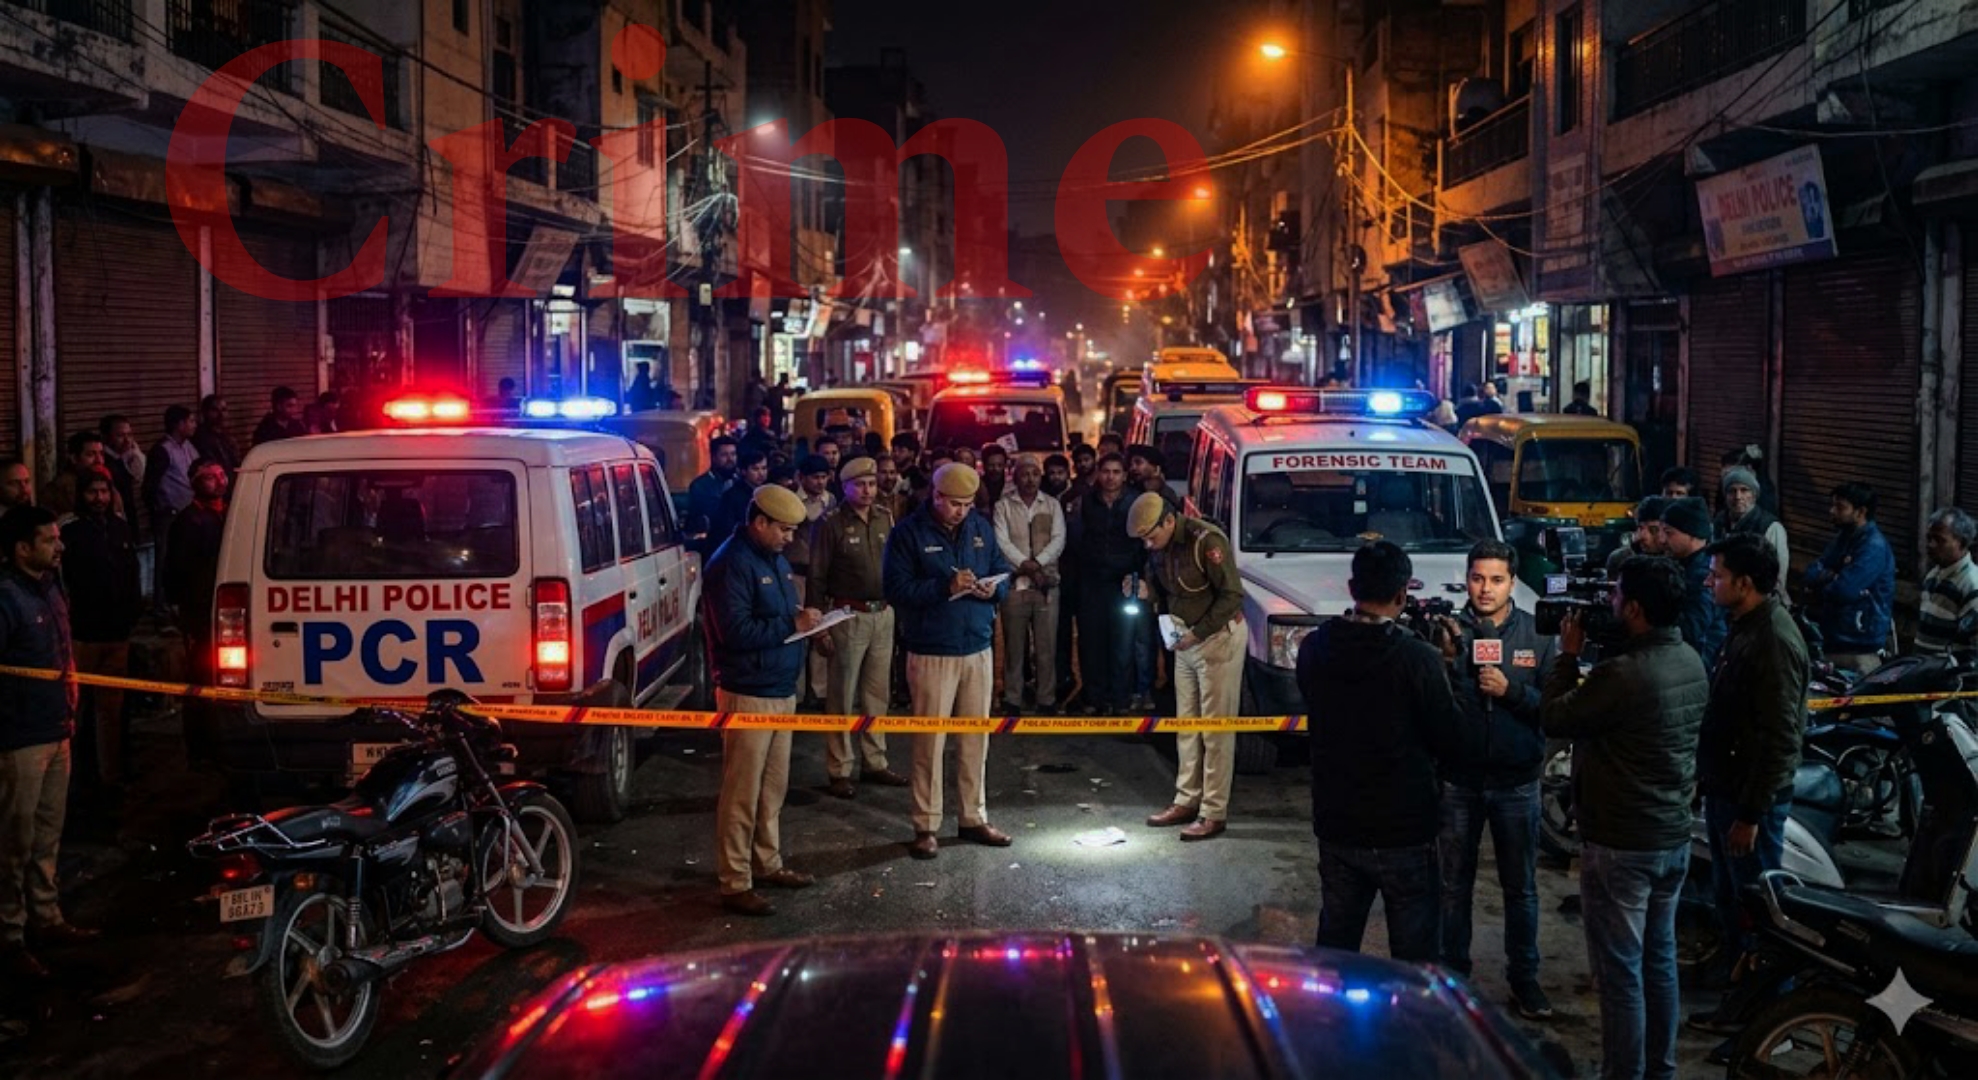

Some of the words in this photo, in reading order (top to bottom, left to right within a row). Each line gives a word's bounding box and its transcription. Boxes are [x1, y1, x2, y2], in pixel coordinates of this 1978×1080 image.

[1752, 174, 1797, 215] POLICE
[1272, 455, 1381, 468] FORENSIC
[1387, 455, 1448, 470] TEAM
[267, 585, 369, 612] DELHI
[383, 583, 511, 611] POLICE
[302, 619, 485, 685] PCR
